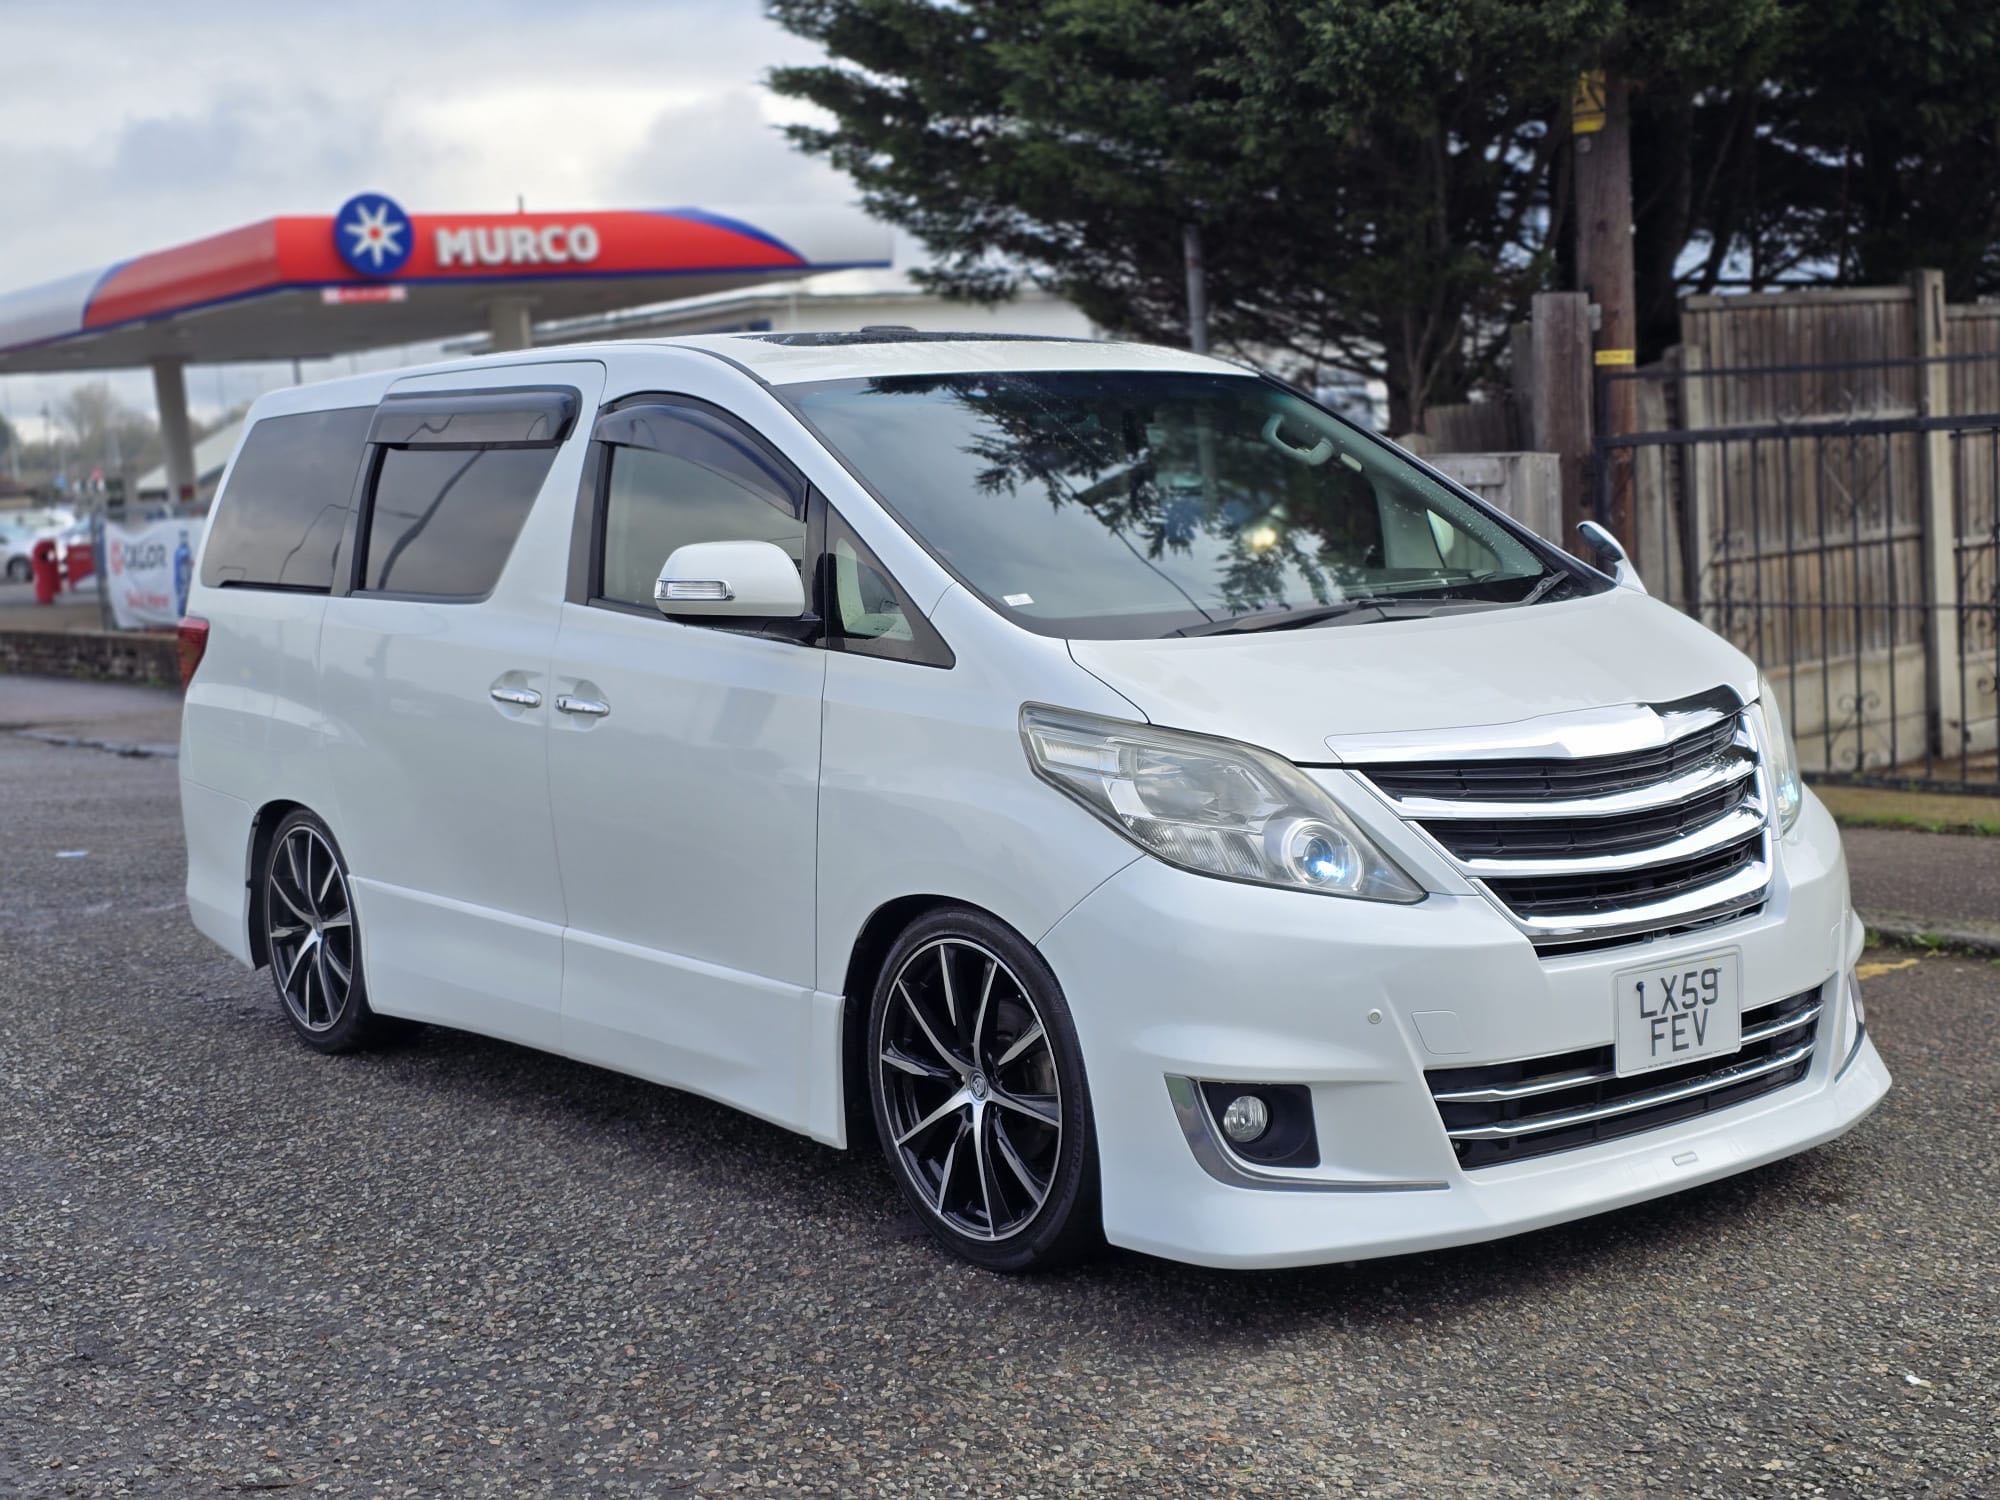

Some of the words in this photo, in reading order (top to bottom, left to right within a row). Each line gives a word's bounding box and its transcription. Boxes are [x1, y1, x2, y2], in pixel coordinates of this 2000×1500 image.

[434, 225, 600, 267] MURCO
[1637, 967, 1721, 1019] LX59
[1651, 1008, 1708, 1056] FEV
